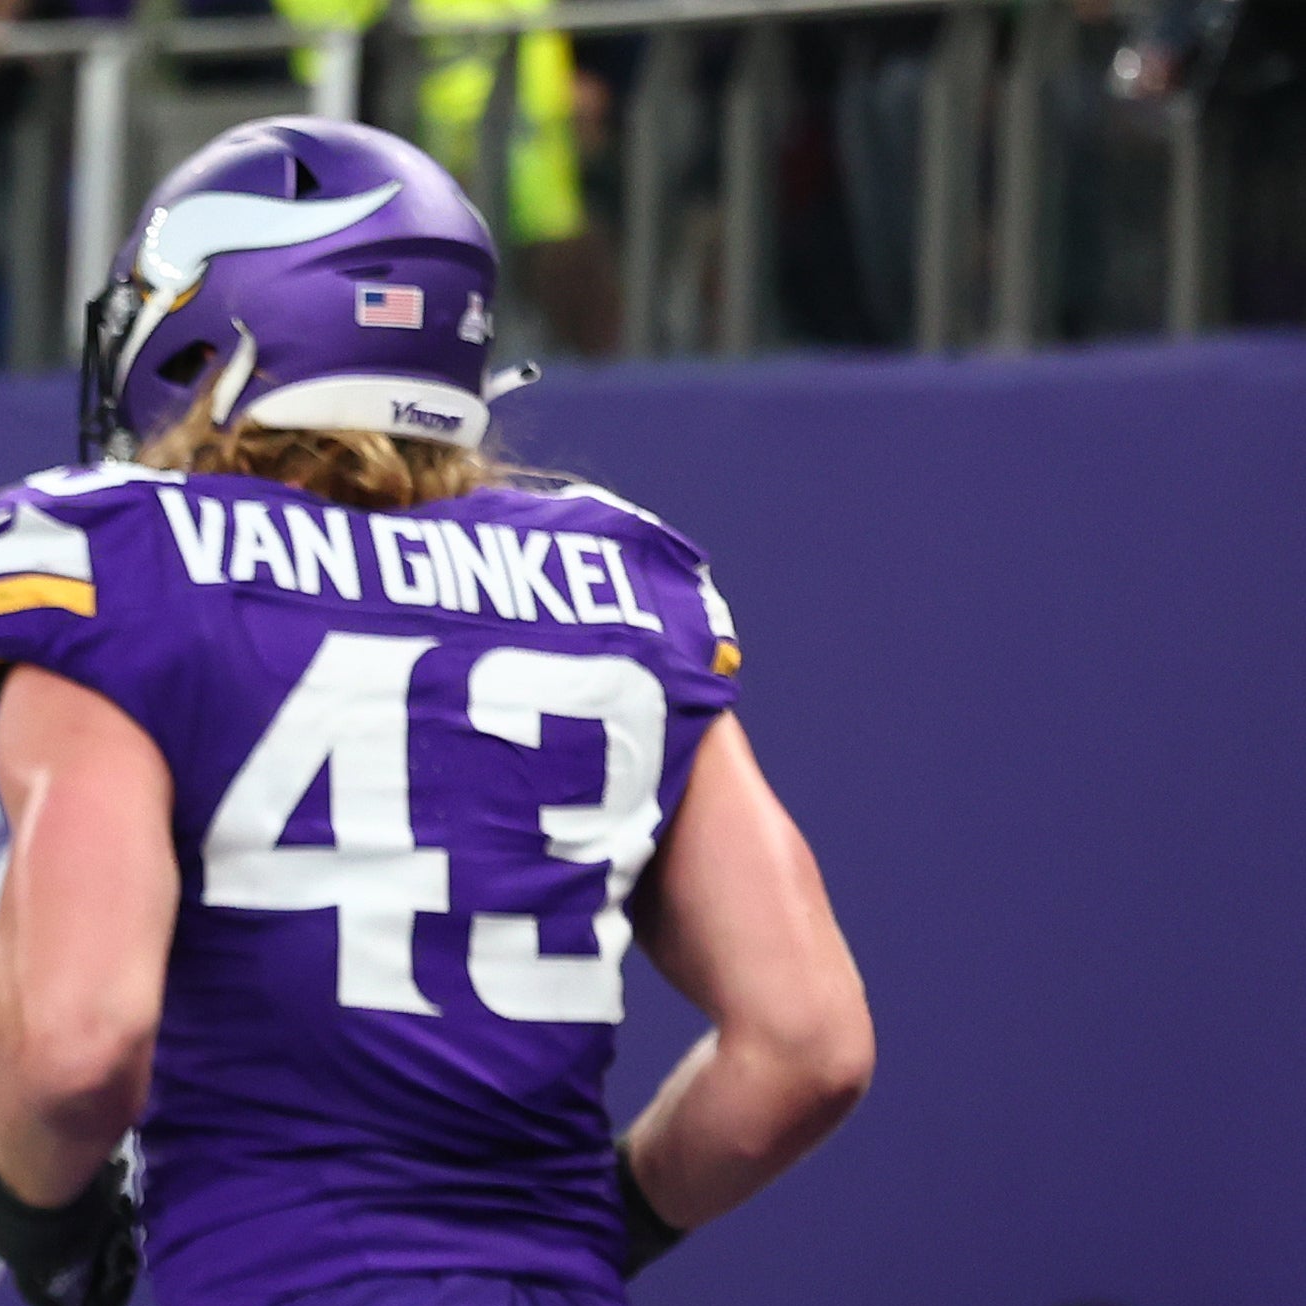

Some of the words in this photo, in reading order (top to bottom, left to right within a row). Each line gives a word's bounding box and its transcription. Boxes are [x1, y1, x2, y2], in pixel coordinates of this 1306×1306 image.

[156, 486, 362, 601] VAN
[367, 511, 664, 633] GINKEL
[201, 629, 668, 1026] 43
